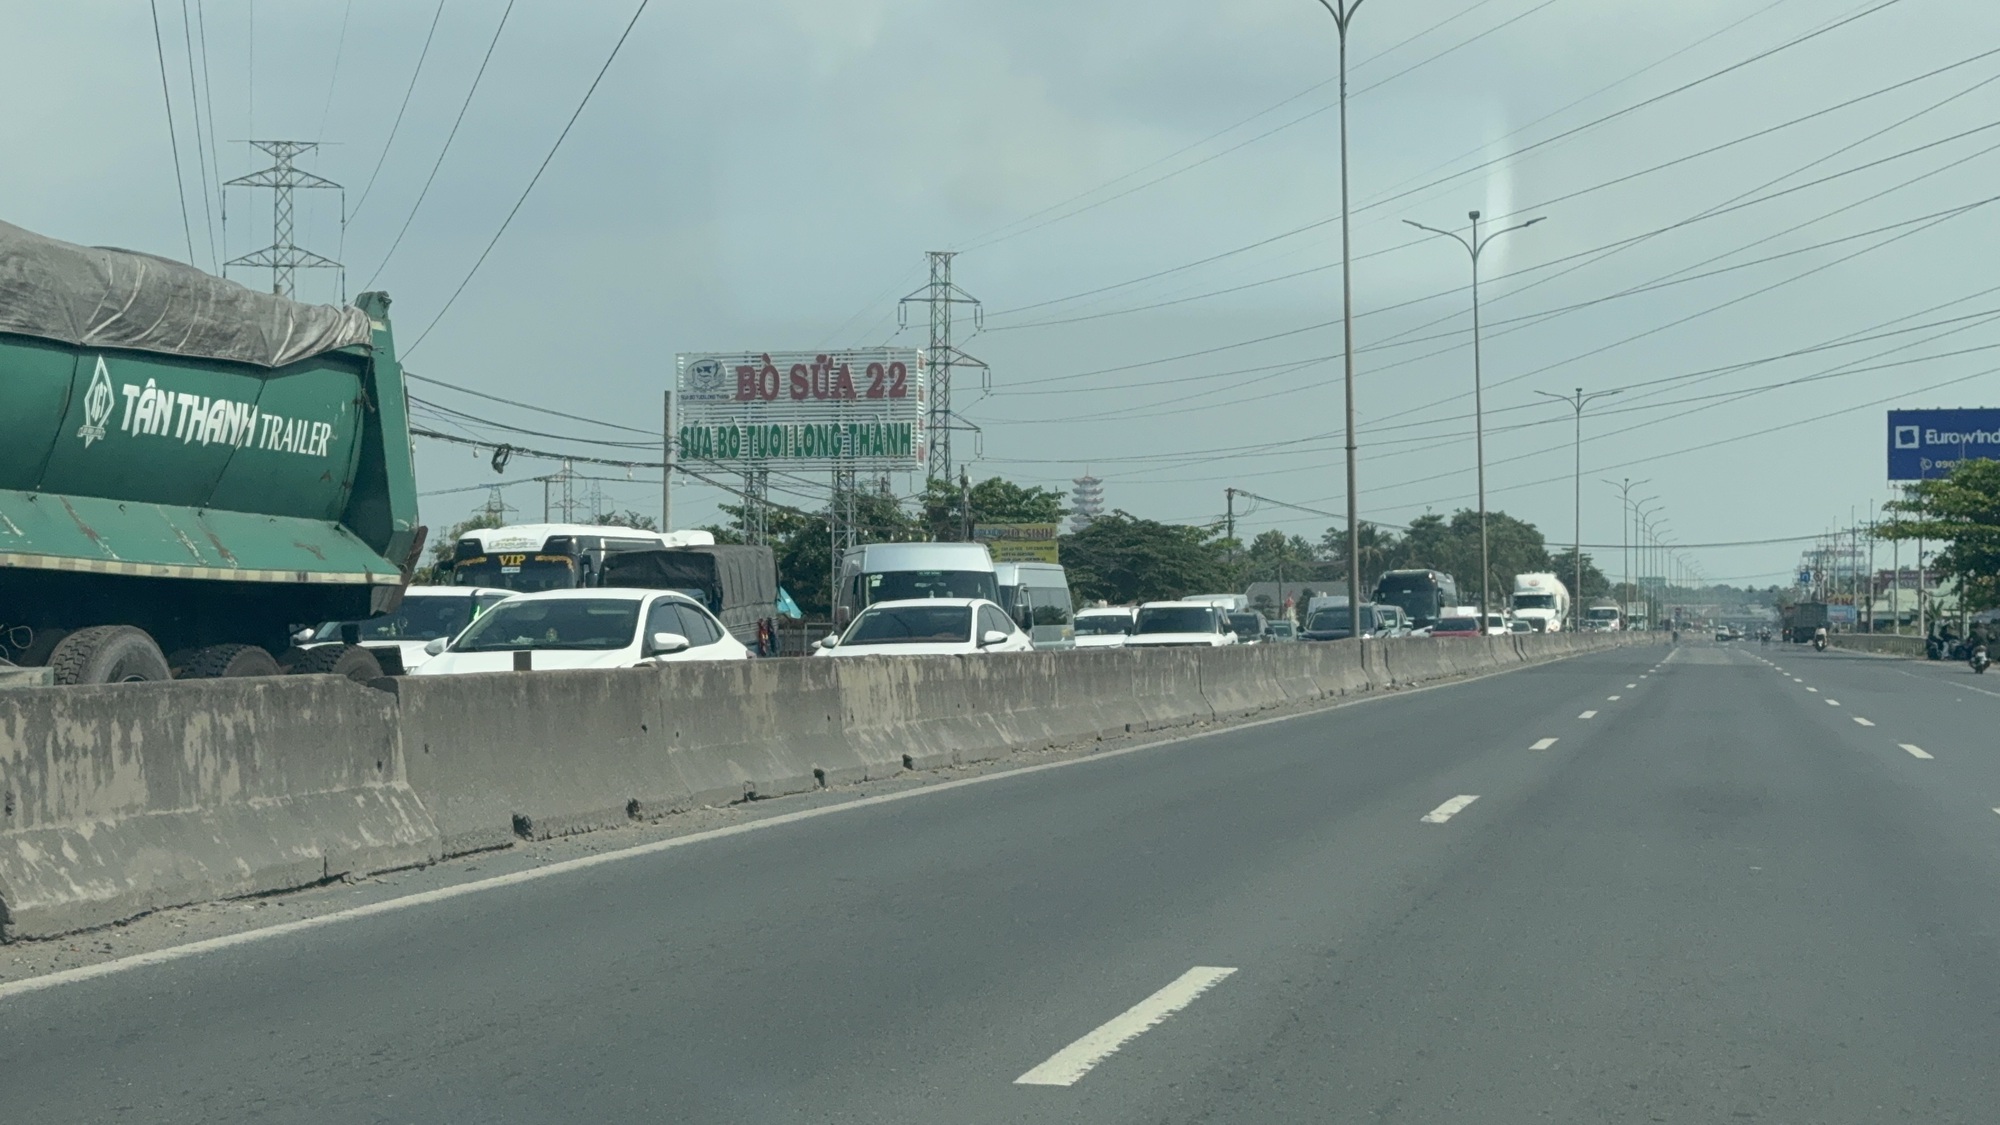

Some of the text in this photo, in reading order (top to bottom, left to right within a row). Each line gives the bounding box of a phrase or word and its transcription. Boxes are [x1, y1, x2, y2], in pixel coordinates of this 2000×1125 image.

[735, 352, 908, 401] BÒ SỮA 22
[121, 377, 175, 438] TÂN
[175, 392, 259, 451] THANH
[259, 413, 331, 457] TRAILER
[717, 416, 741, 458] BÒ
[794, 422, 843, 457] LONG
[848, 414, 912, 456] THÀNH
[1925, 427, 2000, 445] Eurowind
[498, 554, 527, 566] VIP
